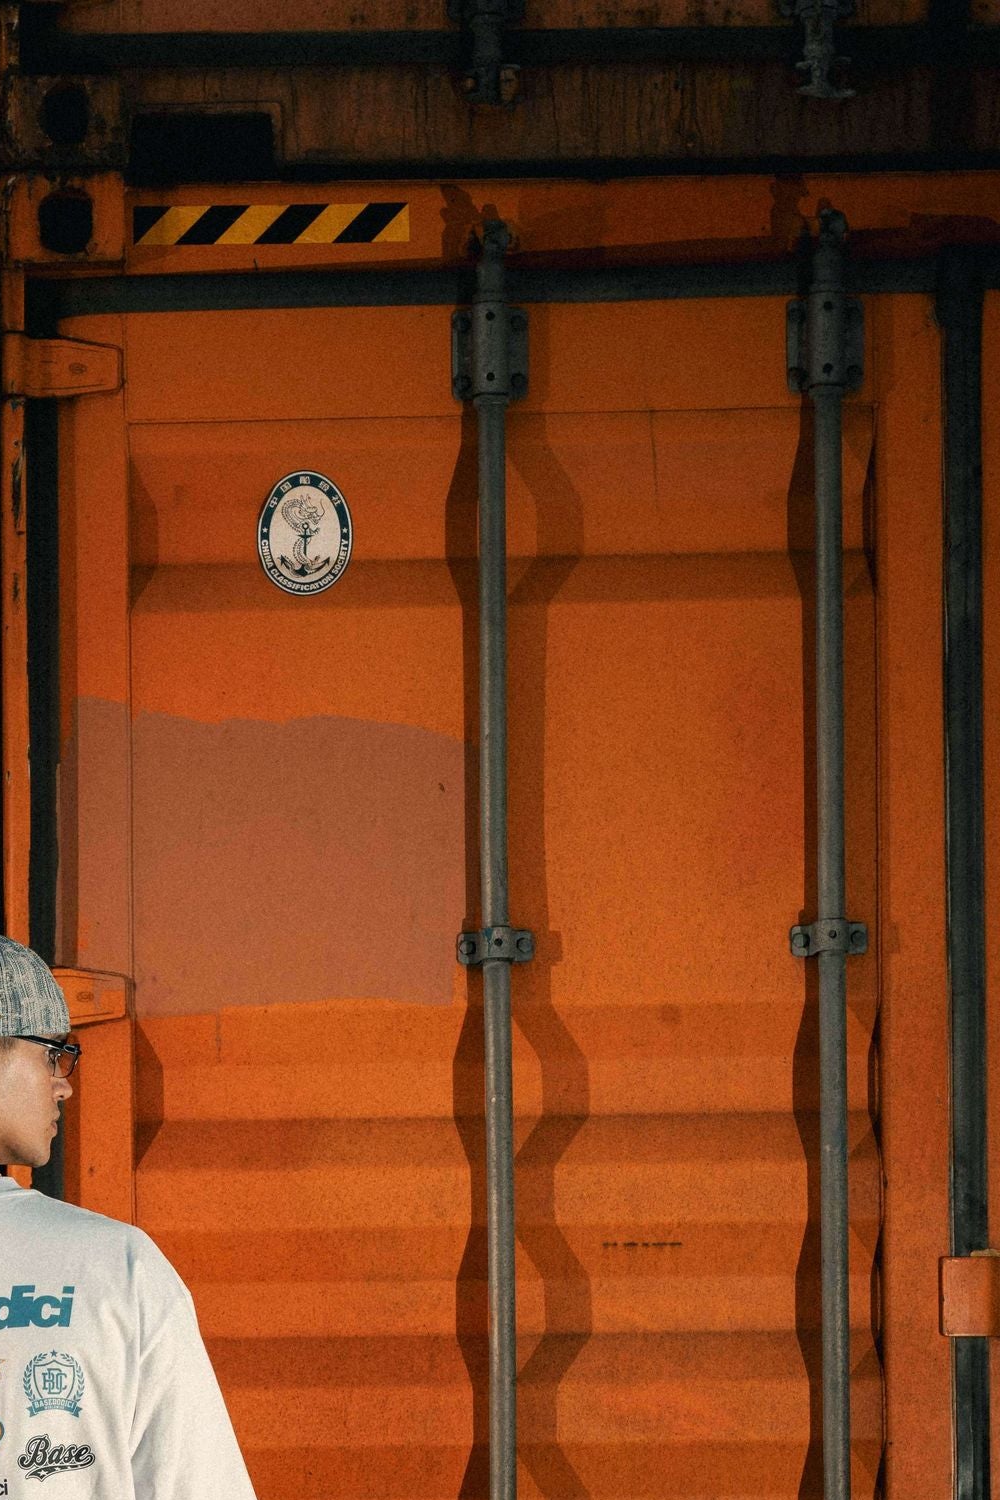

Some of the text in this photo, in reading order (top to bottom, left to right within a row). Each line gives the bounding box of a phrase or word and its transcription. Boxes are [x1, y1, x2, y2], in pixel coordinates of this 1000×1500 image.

[261, 538, 350, 591] CHINA CLASSIFICATION SOCIETY
[19, 1435, 92, 1468] Base
